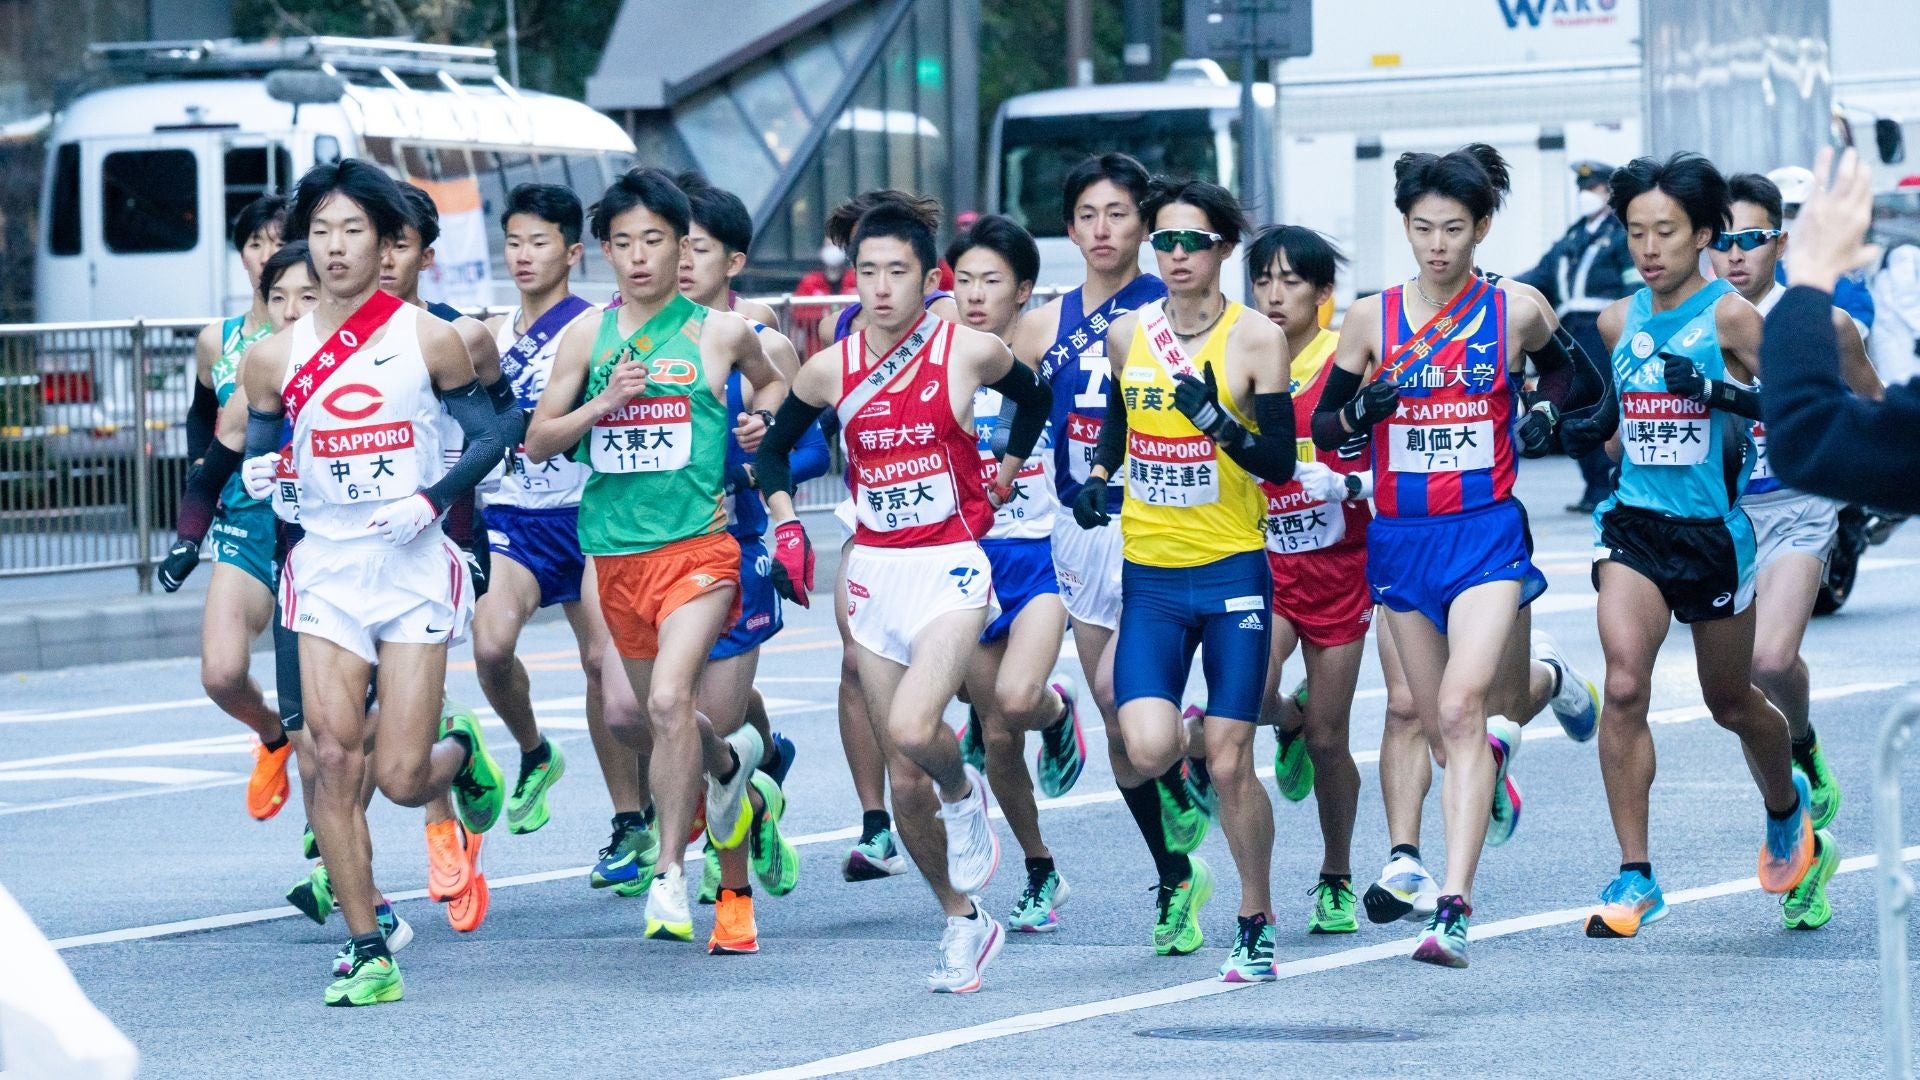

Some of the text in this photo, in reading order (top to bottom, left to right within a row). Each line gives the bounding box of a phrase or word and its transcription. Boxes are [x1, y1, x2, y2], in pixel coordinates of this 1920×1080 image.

[1413, 400, 1488, 421] SAPPORO
[1636, 398, 1706, 414] SAPPORO
[328, 428, 410, 453] SAPPORO
[602, 426, 674, 452] 大東大
[858, 422, 936, 451] 帝京大学
[1406, 426, 1477, 452] 創価大
[1627, 421, 1702, 444] 山梨学大
[1139, 440, 1212, 459] SAPPORO
[1640, 446, 1677, 463] 17-1
[617, 453, 659, 470] 11-1
[865, 453, 942, 484] SAPPORO
[1425, 453, 1459, 470] 7-1
[1131, 457, 1212, 488] 関東学生連合
[348, 484, 382, 500] 6-1
[523, 476, 550, 490] 3-1
[867, 482, 935, 512] 帝京大
[1147, 487, 1187, 505] 21-1
[886, 512, 920, 528] 9-1
[1279, 535, 1320, 552] 13-1
[1238, 622, 1264, 631] adidas
